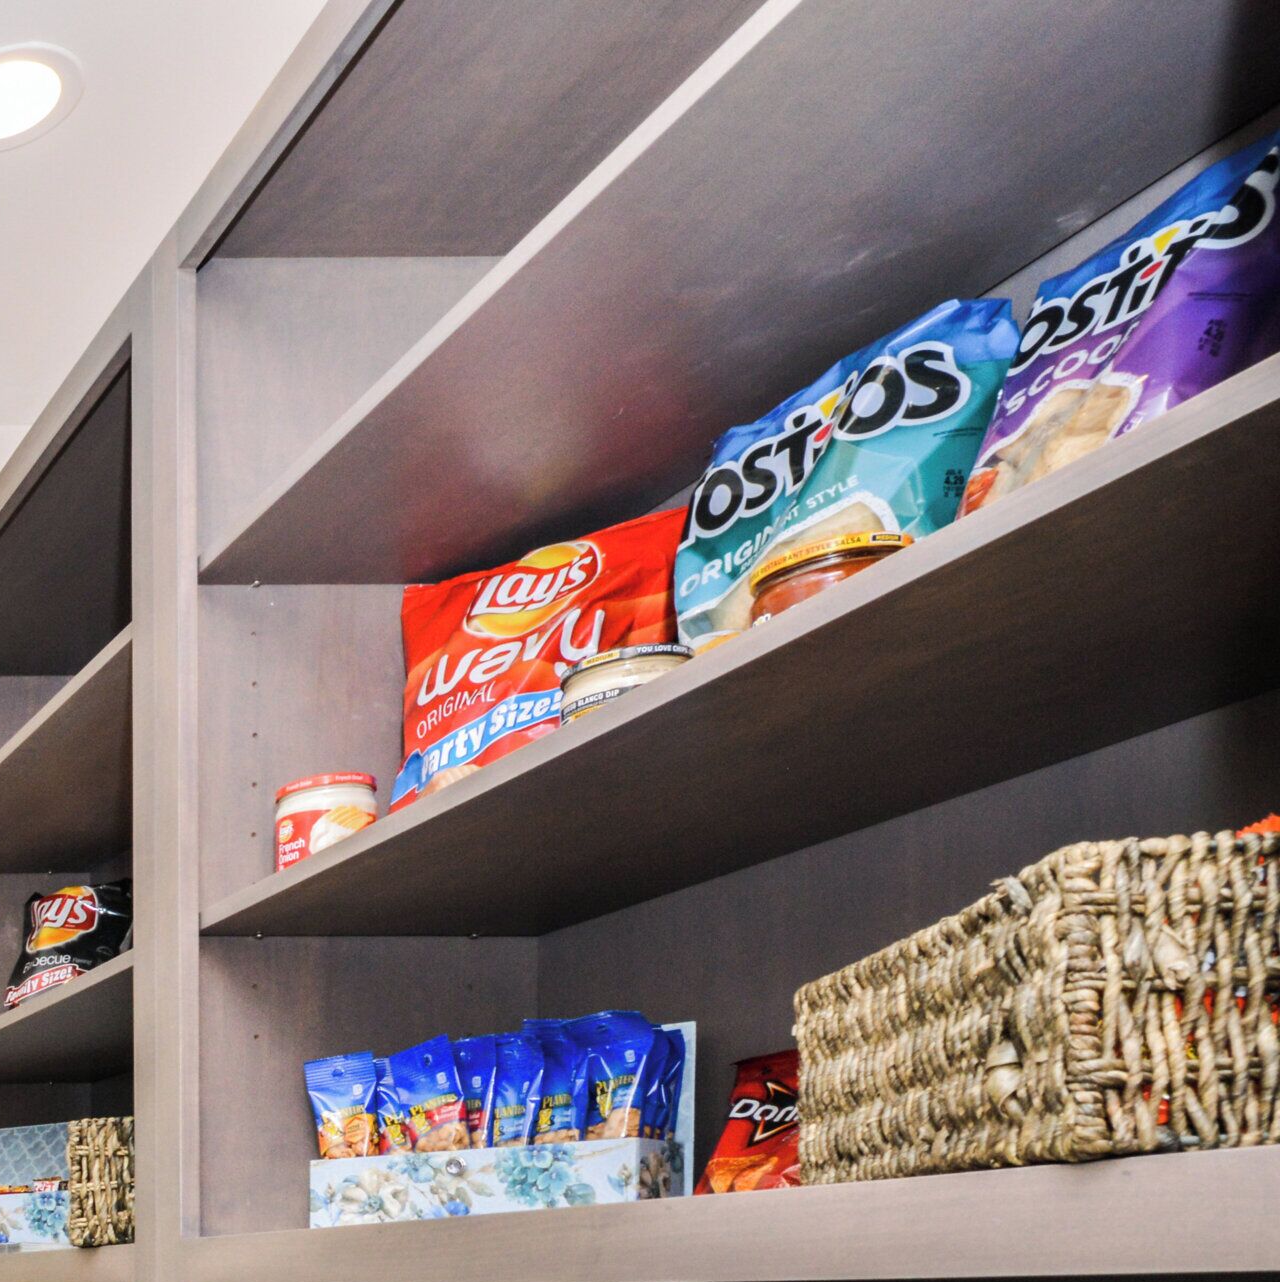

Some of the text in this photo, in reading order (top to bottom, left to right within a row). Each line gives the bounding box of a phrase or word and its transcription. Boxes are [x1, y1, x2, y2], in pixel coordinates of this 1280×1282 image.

[807, 474, 860, 510] STYLE
[835, 536, 862, 547] SALSA
[471, 555, 593, 617] Lay's
[416, 607, 605, 707] wavy
[636, 646, 653, 654] YOU
[654, 644, 672, 653] LOVE
[416, 682, 496, 740] ORIGINAL
[605, 688, 620, 699] DIP
